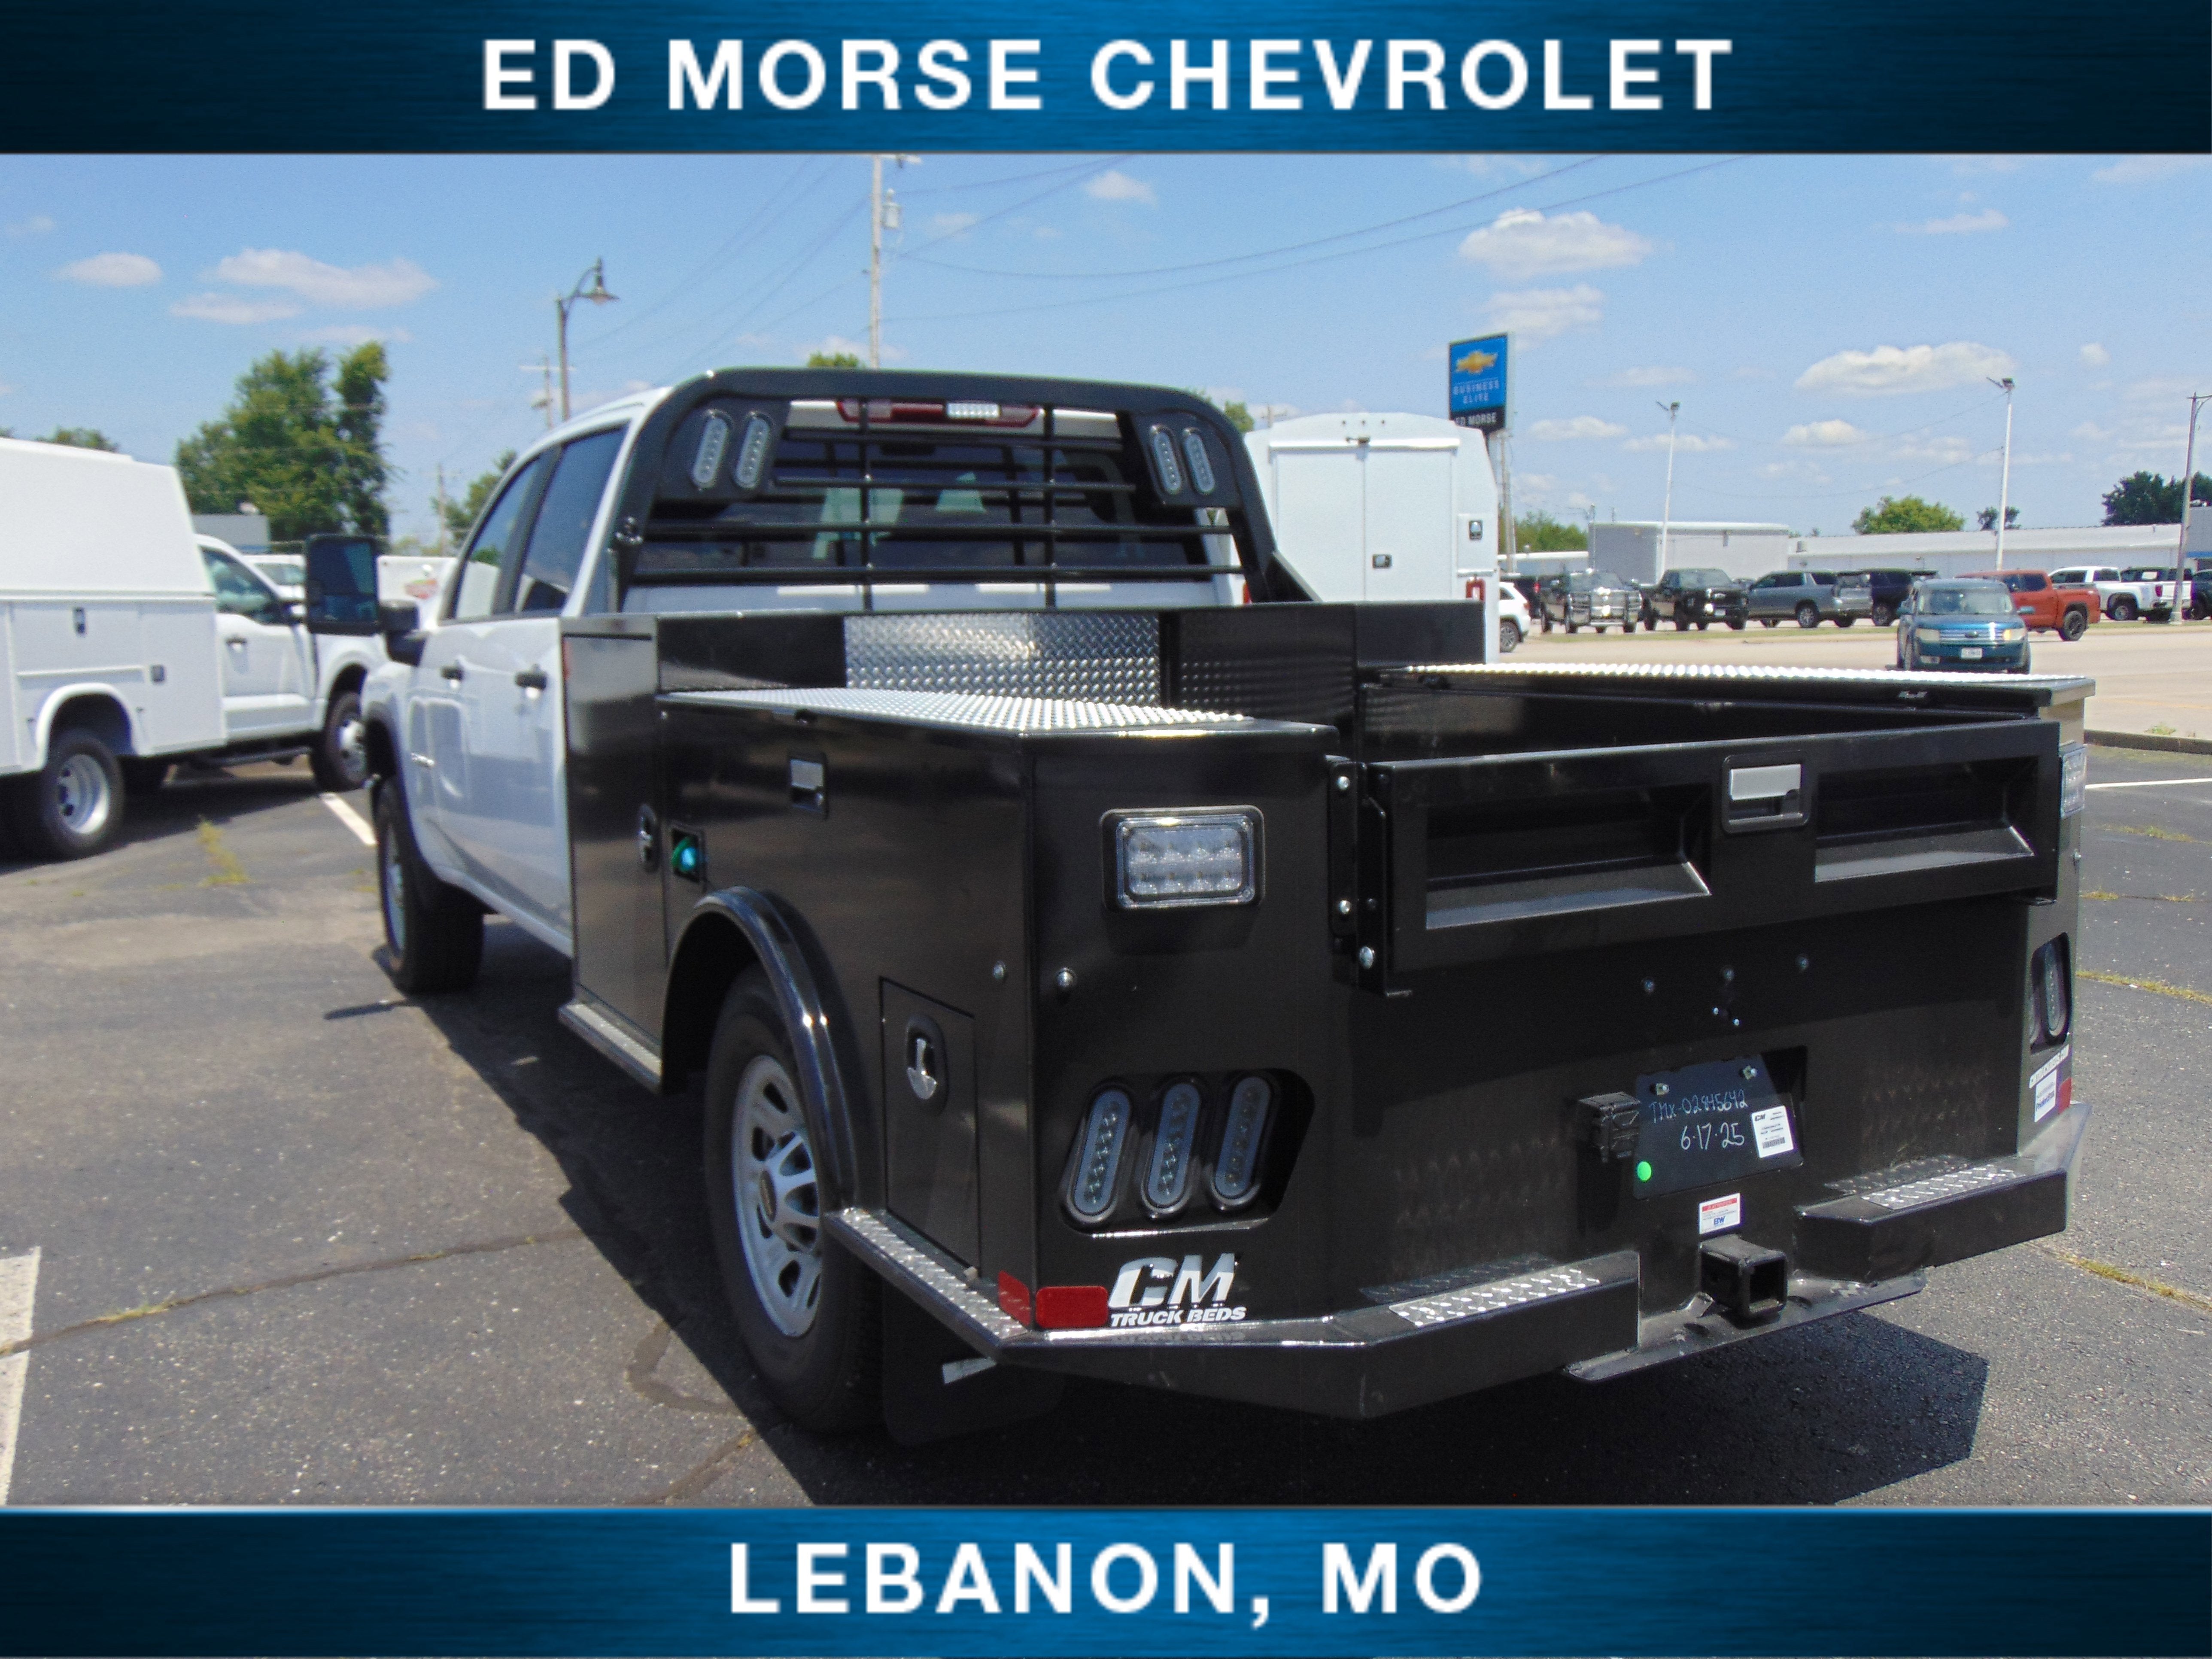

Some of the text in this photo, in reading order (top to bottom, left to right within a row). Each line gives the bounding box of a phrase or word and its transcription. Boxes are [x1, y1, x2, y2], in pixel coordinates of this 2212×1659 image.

[1107, 1252, 1235, 1308] CM
[1110, 1306, 1246, 1327] TRUCK BEDS
